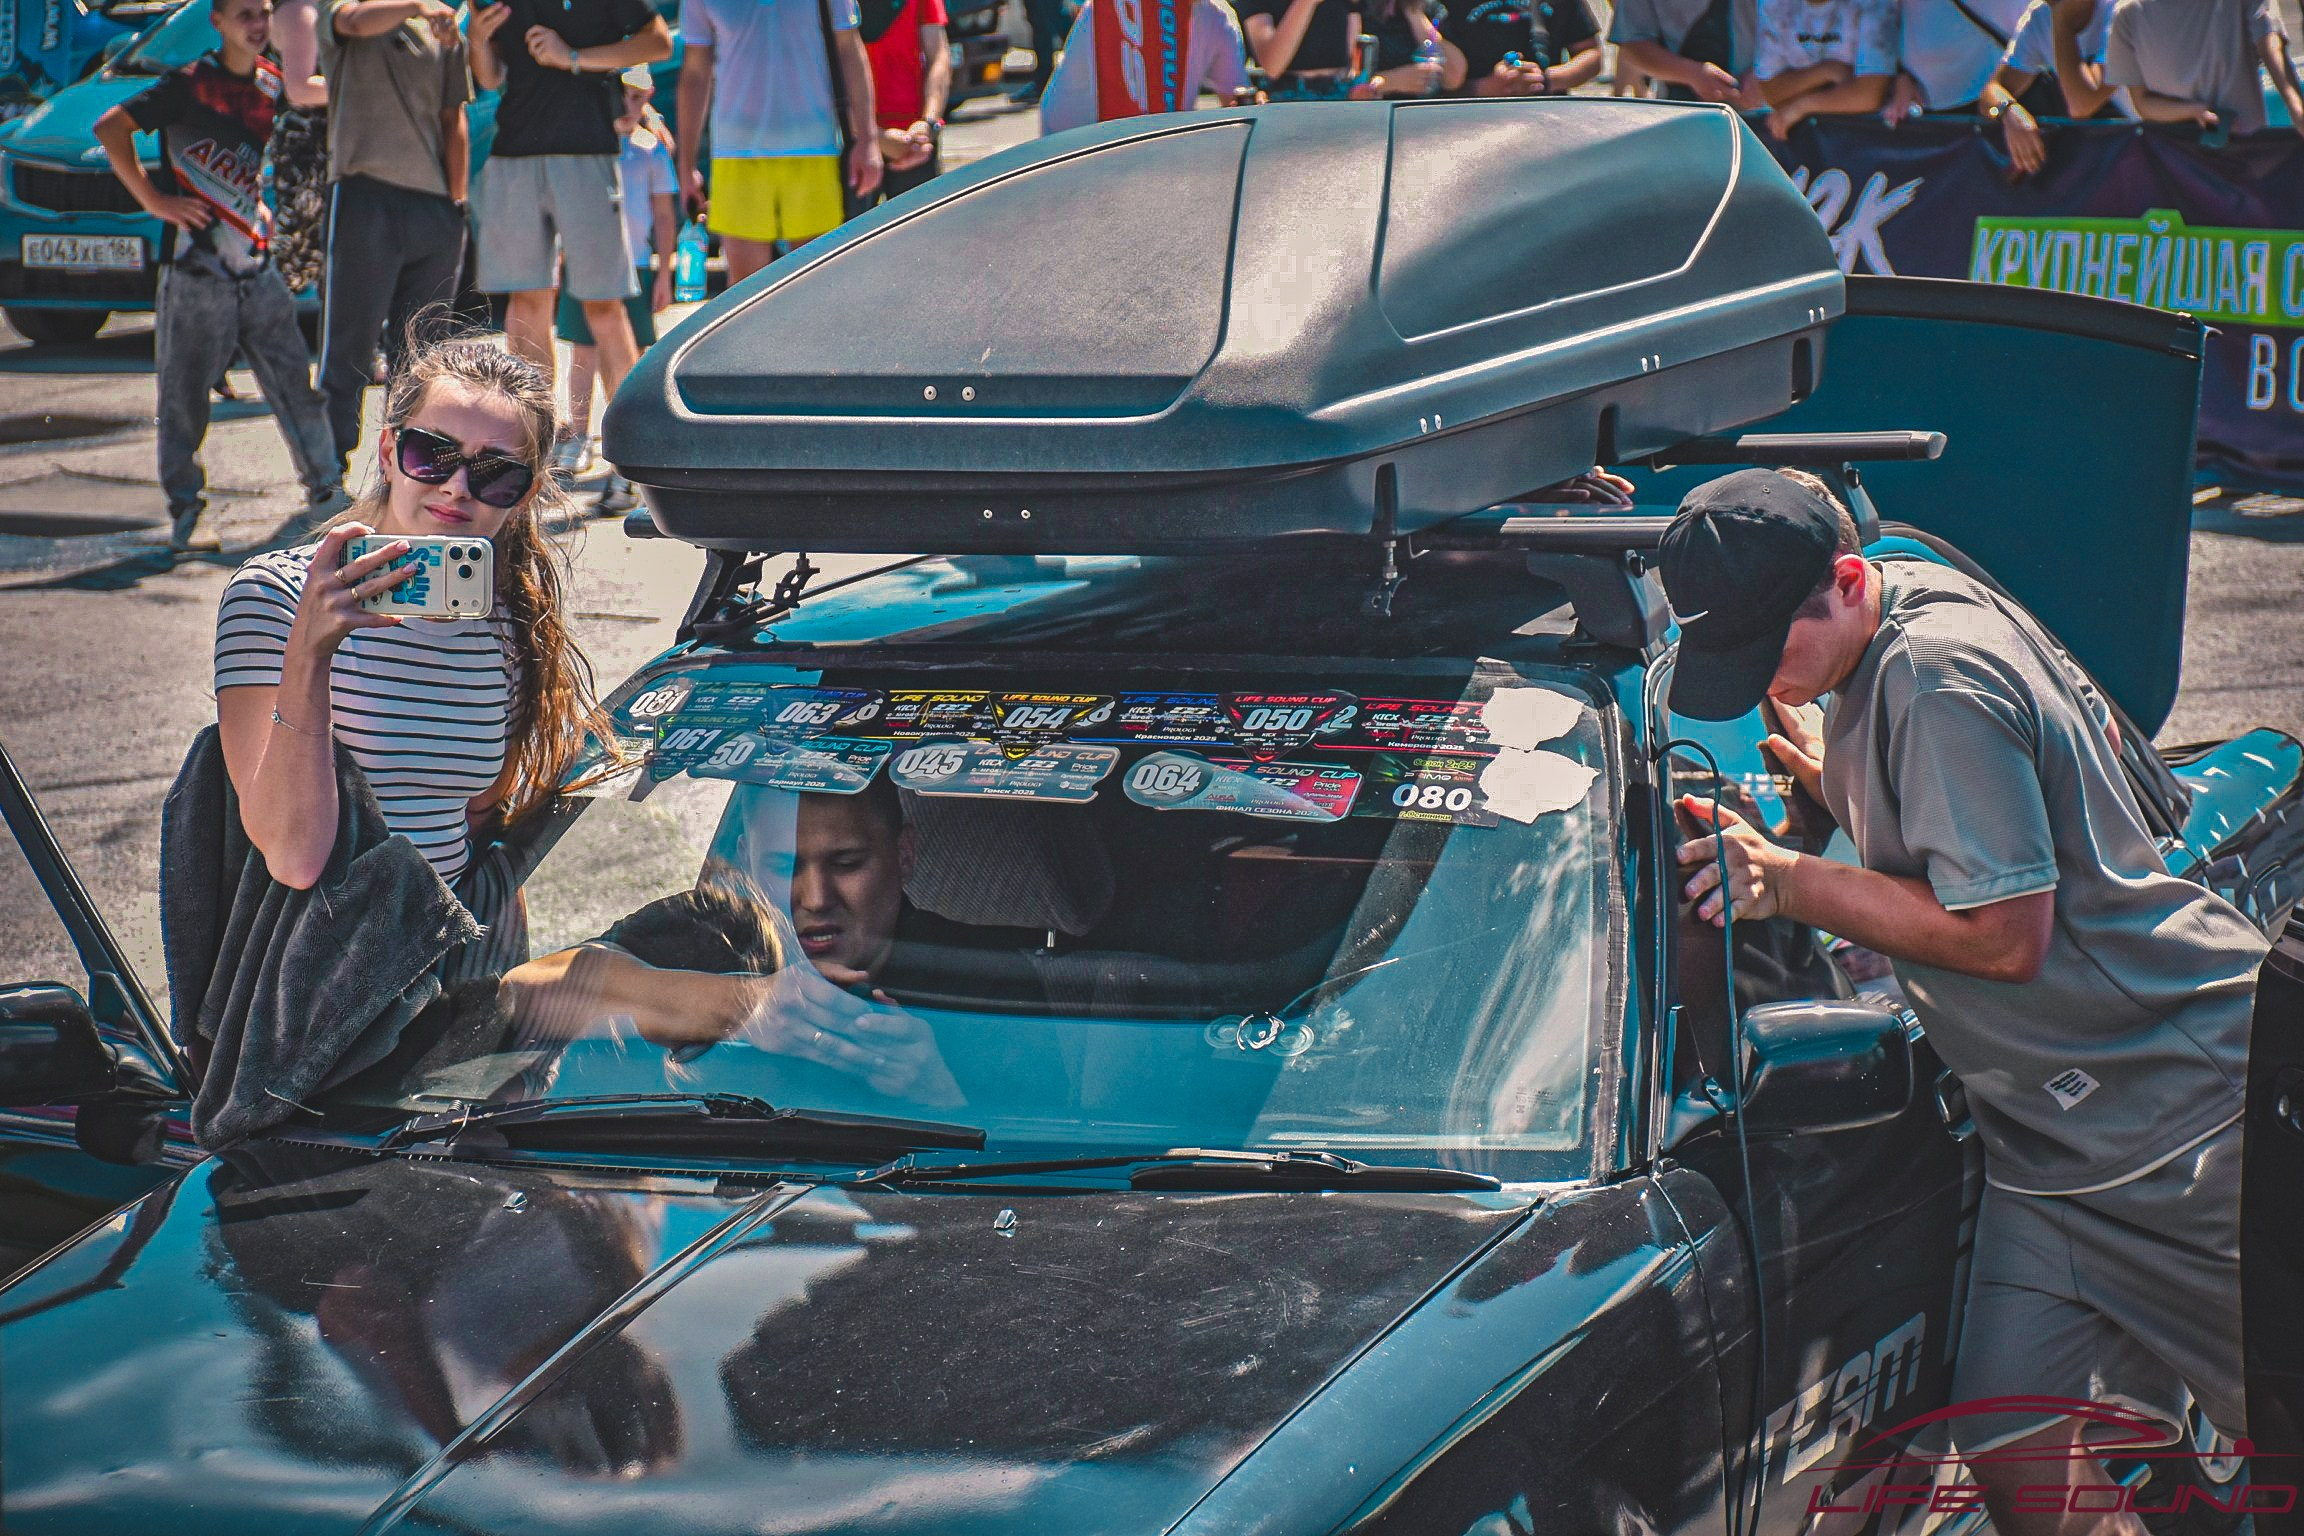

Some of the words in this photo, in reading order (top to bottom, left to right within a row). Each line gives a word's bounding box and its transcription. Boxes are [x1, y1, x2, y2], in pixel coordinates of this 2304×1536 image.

[1973, 219, 2271, 315] КРУПНЕЙШАЯ
[891, 694, 926, 702] LIFE
[1031, 694, 1069, 702] SOUND
[1071, 695, 1098, 703] CUP
[1266, 696, 1308, 704] SOUND
[1129, 706, 1156, 714] KICX
[1364, 703, 1403, 711] LIFE
[775, 701, 841, 724] 063
[1003, 706, 1073, 729] 054
[1372, 713, 1400, 721] KICX
[1242, 708, 1313, 731] 050
[660, 728, 722, 750] 061
[1134, 733, 1191, 741] Красноярск
[799, 741, 851, 751] SOUND
[853, 744, 889, 752] CUP
[1075, 752, 1113, 760] CUP
[897, 749, 969, 775] 045
[978, 759, 1006, 767] KICX
[1255, 766, 1315, 777] SOUND
[1319, 770, 1358, 779] CUP
[1132, 764, 1201, 792] 064
[1392, 783, 1473, 812] 080
[1215, 805, 1252, 813] ФИНАЛ
[1254, 806, 1293, 815] СЕЗОНА
